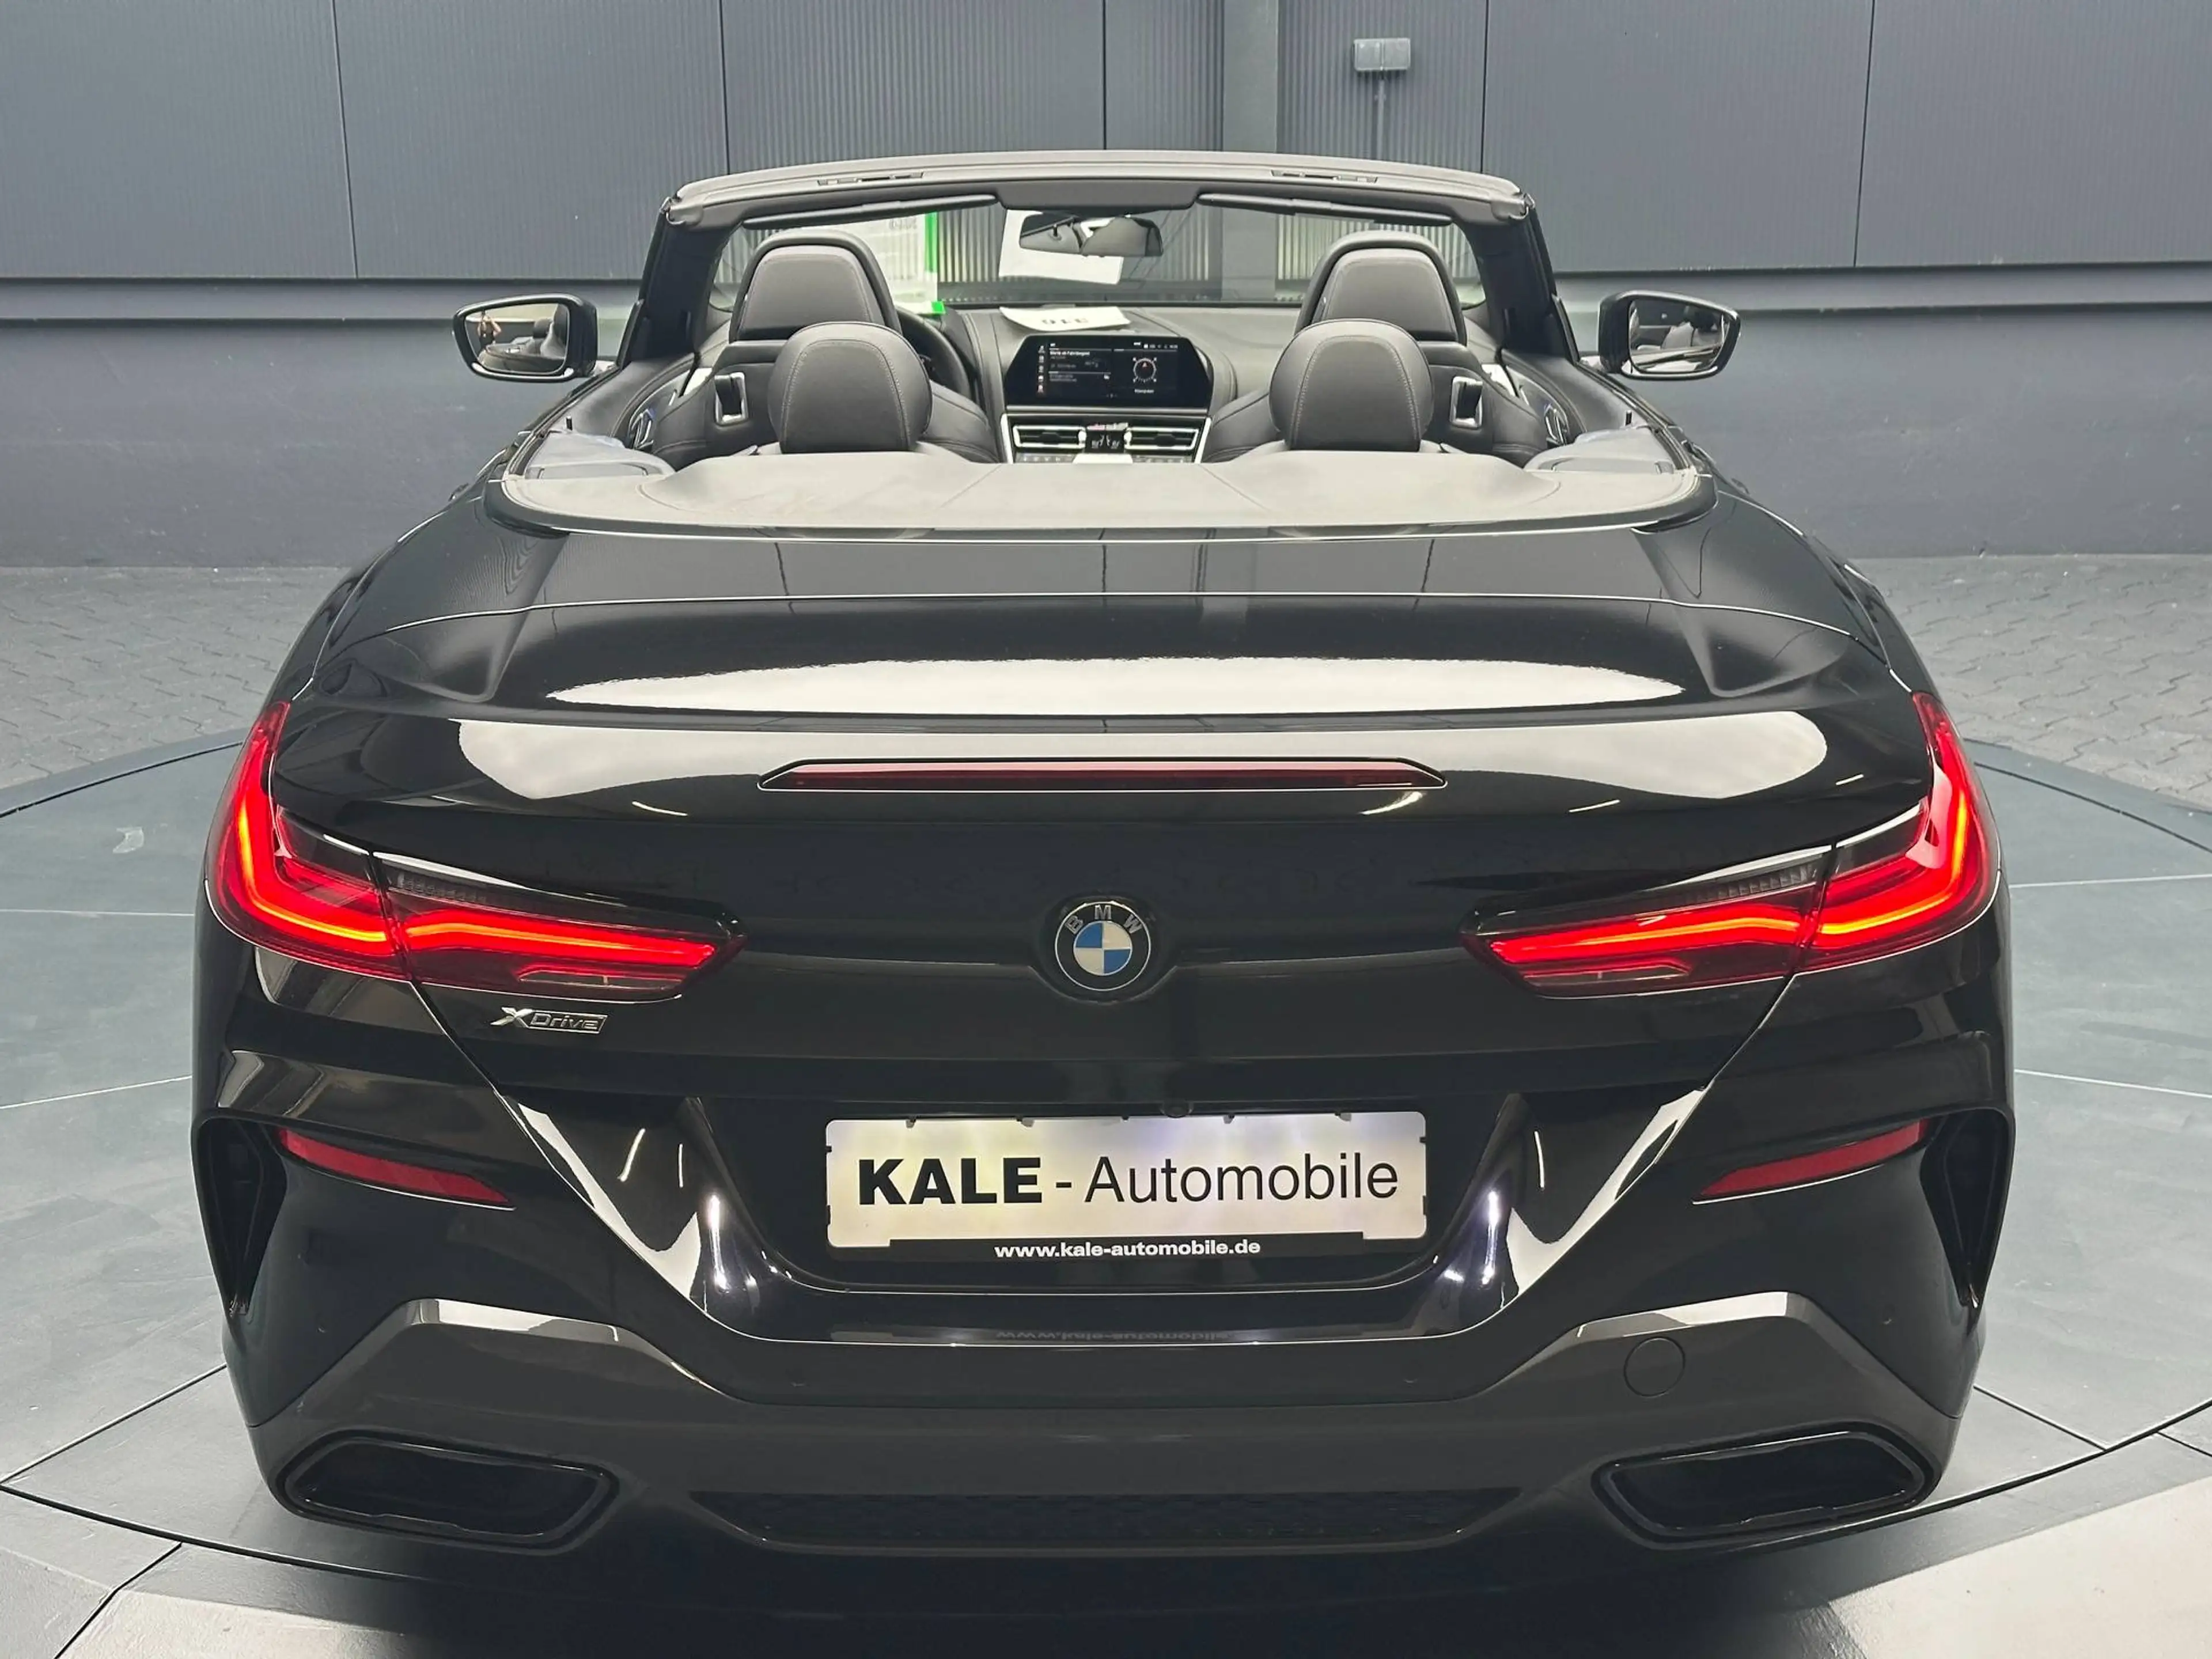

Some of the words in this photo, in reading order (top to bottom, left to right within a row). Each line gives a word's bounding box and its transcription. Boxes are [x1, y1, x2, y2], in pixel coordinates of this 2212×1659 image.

[1065, 904, 1143, 935] BMW
[859, 1157, 1042, 1205] KALE
[1084, 1152, 1398, 1204] Automobile
[994, 1238, 1261, 1258] www.kale-automobile.de
